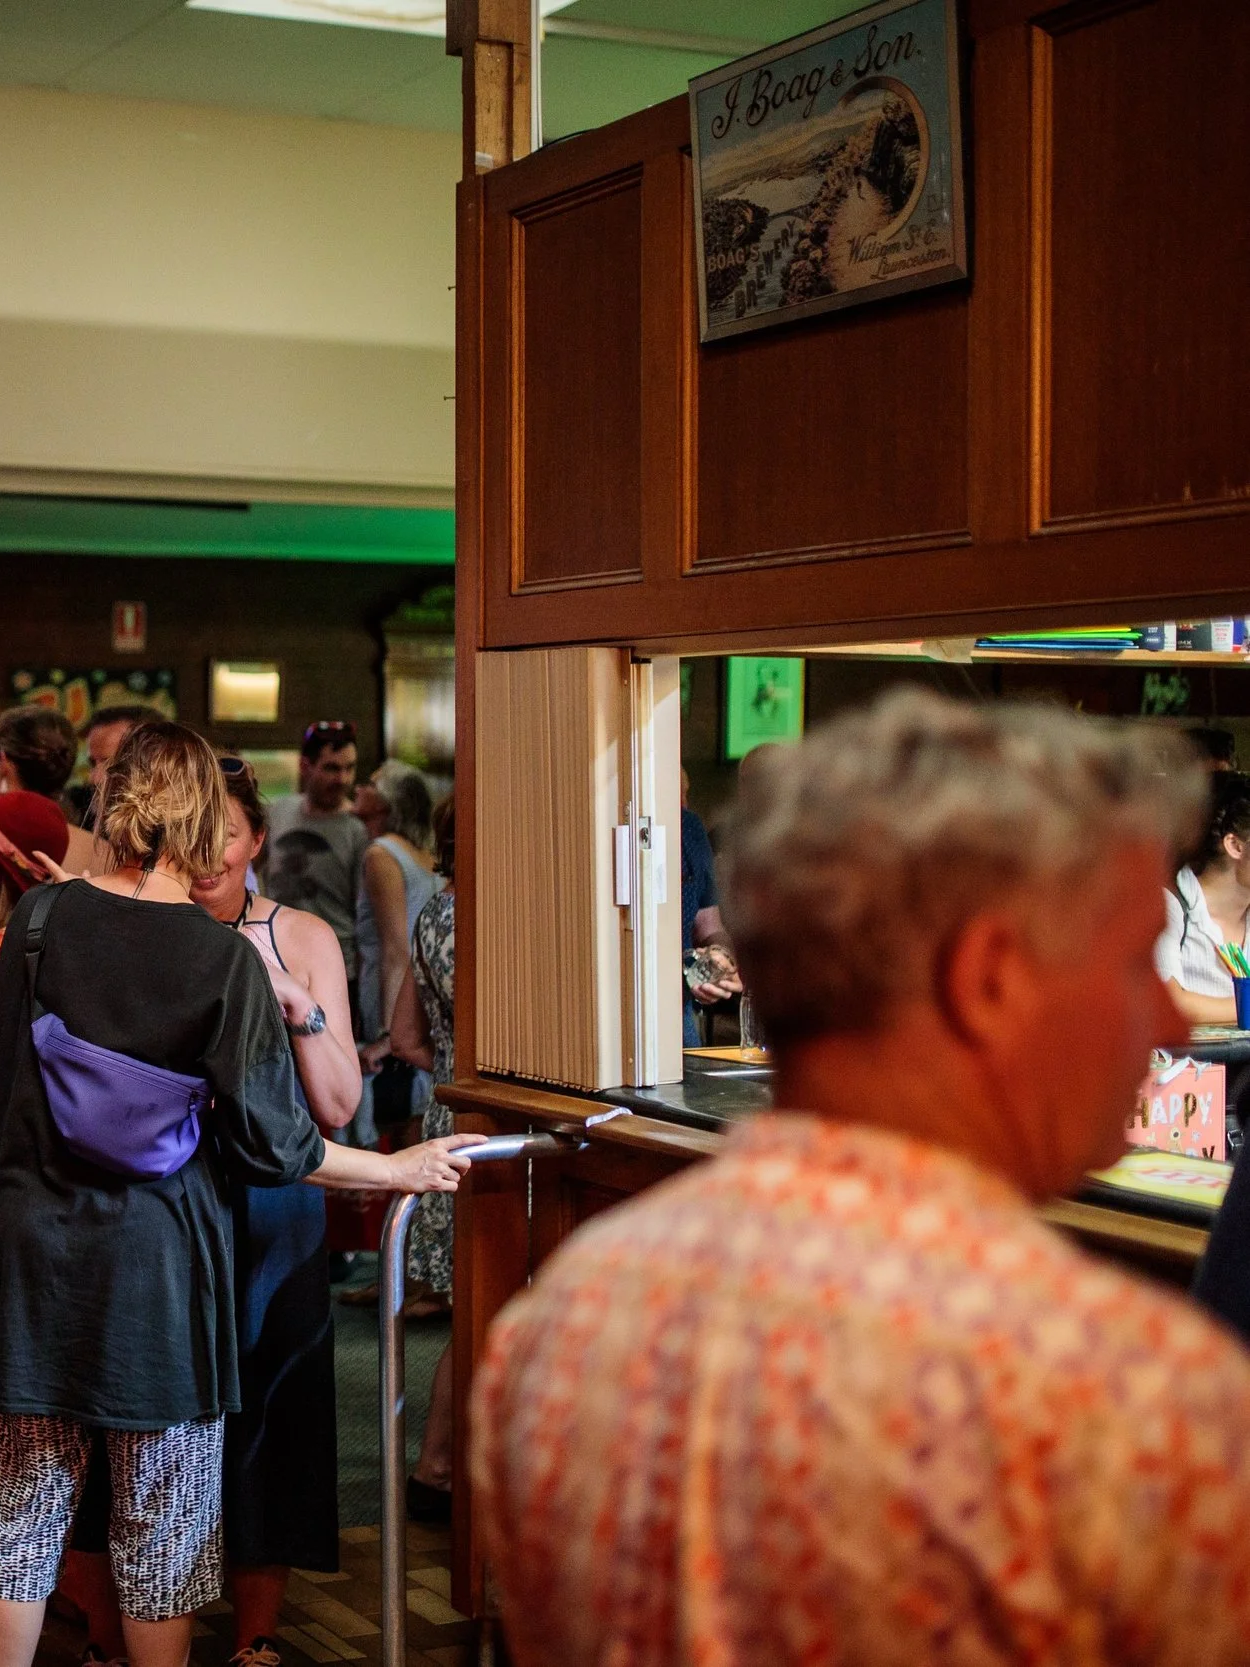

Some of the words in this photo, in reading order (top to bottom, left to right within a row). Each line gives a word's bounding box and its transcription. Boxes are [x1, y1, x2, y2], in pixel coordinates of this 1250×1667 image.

[745, 69, 826, 129] Boag
[830, 59, 848, 88] &
[851, 24, 922, 79] Son.
[707, 244, 761, 273] BOAG'S
[847, 231, 903, 266] William
[734, 219, 798, 319] BREWERY
[1127, 1091, 1214, 1129] HAPPY
